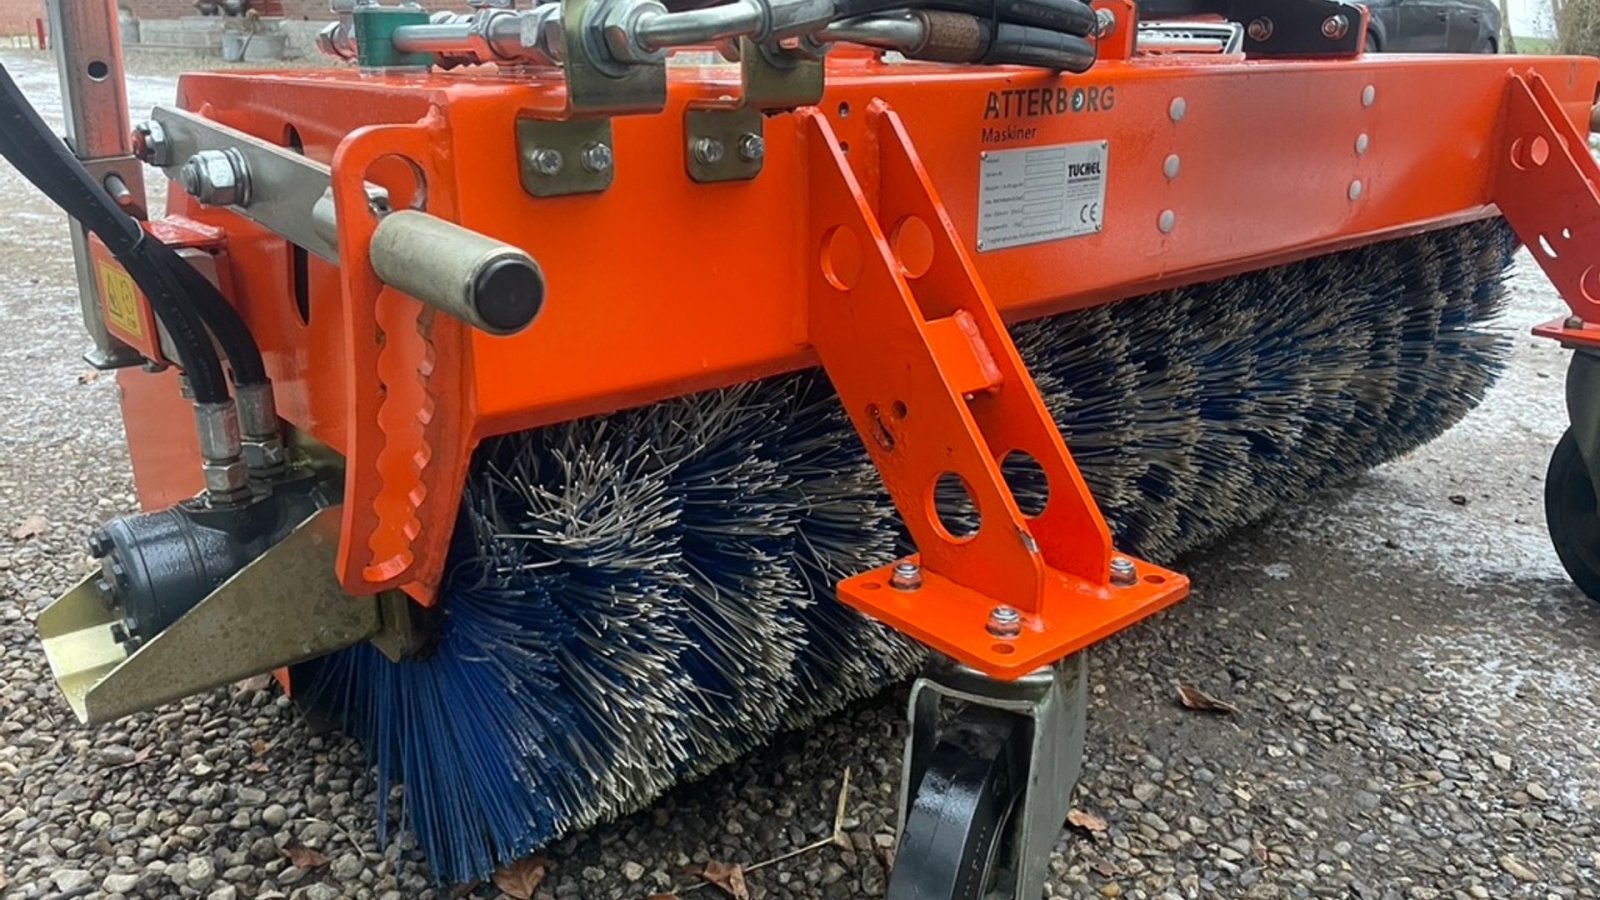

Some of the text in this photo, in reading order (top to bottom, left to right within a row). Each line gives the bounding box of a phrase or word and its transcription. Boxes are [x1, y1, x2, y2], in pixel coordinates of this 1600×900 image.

[984, 86, 1115, 119] ATTERBORG
[981, 126, 1036, 143] Maskiner
[1068, 162, 1101, 177] TUCHEL
